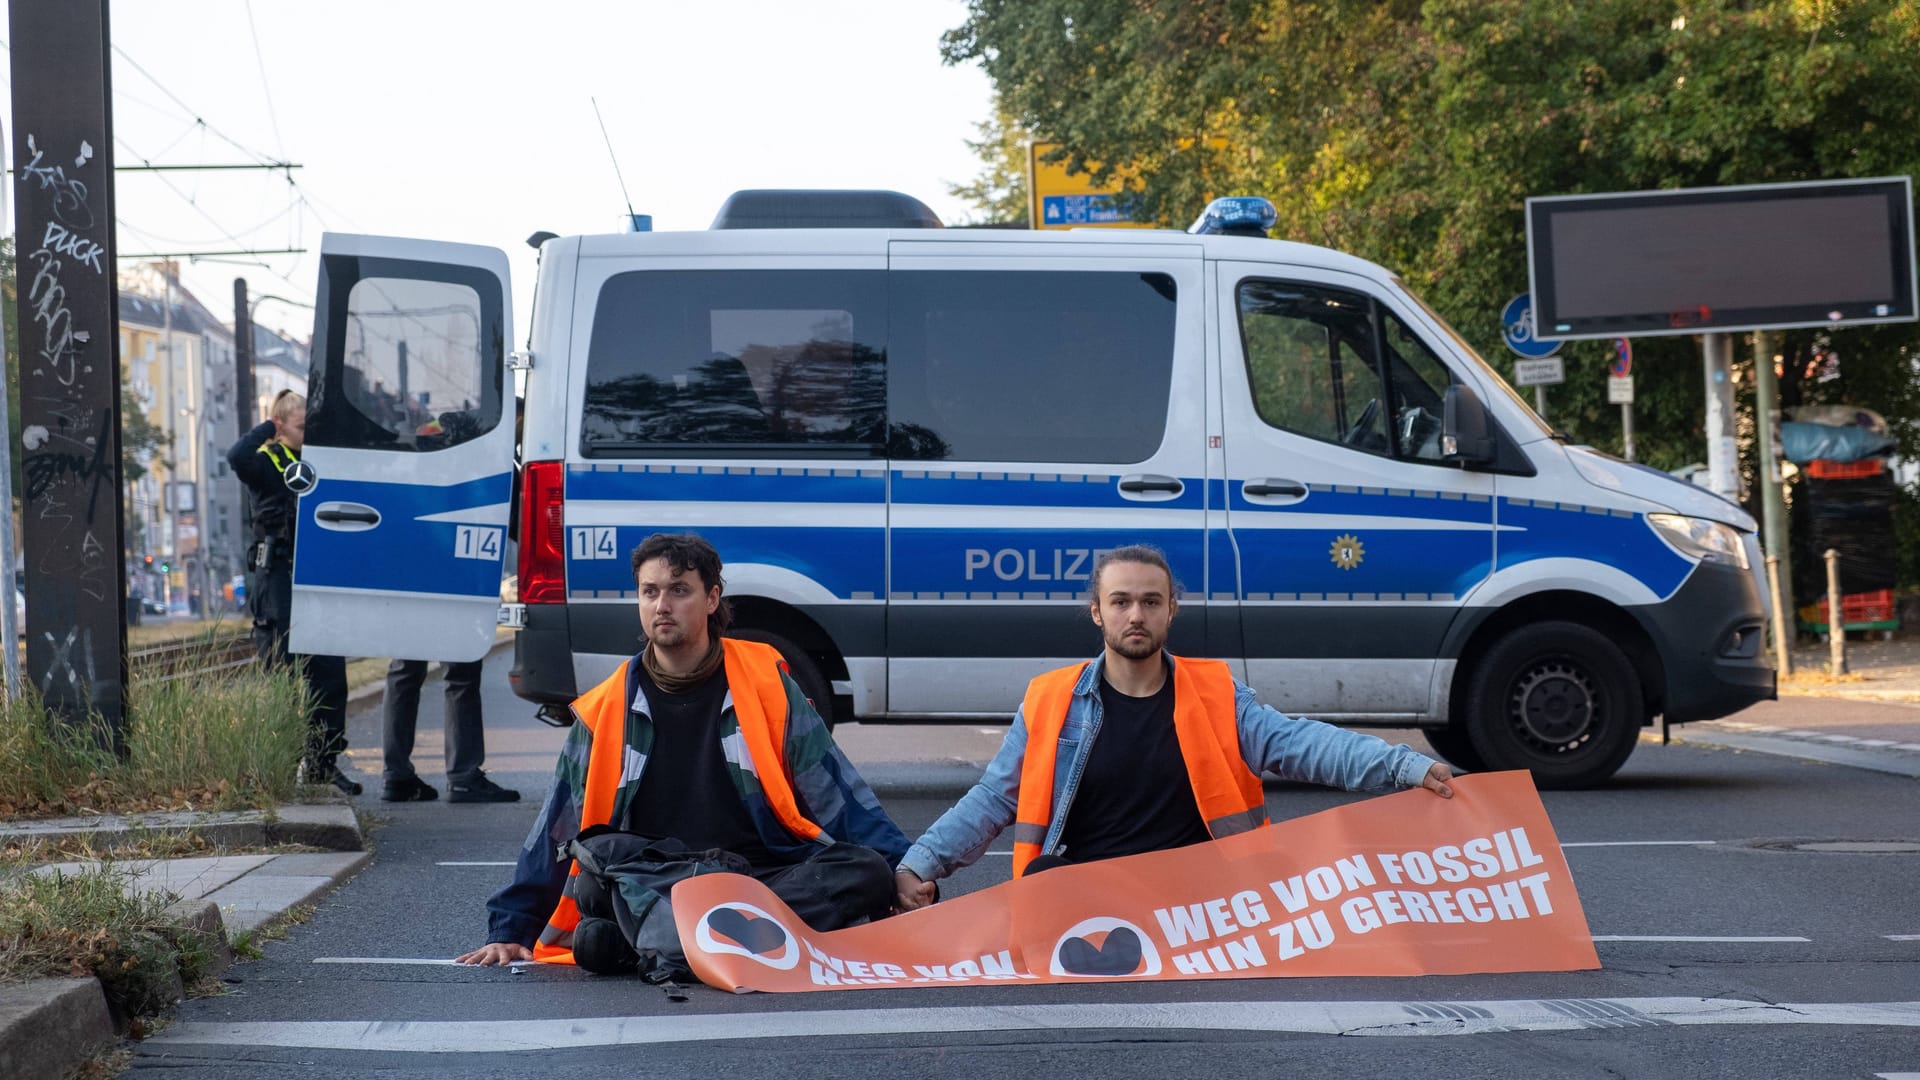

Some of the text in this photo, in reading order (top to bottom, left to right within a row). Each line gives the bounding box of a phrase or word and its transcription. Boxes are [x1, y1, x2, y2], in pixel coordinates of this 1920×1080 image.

[461, 529, 498, 557] 14
[577, 530, 614, 557] 14
[965, 548, 1112, 580] POLIZ
[1154, 827, 1543, 949] WEG VON FOSSIL
[1172, 872, 1553, 975] HIN ZU GERECHT
[800, 935, 908, 979] WEG
